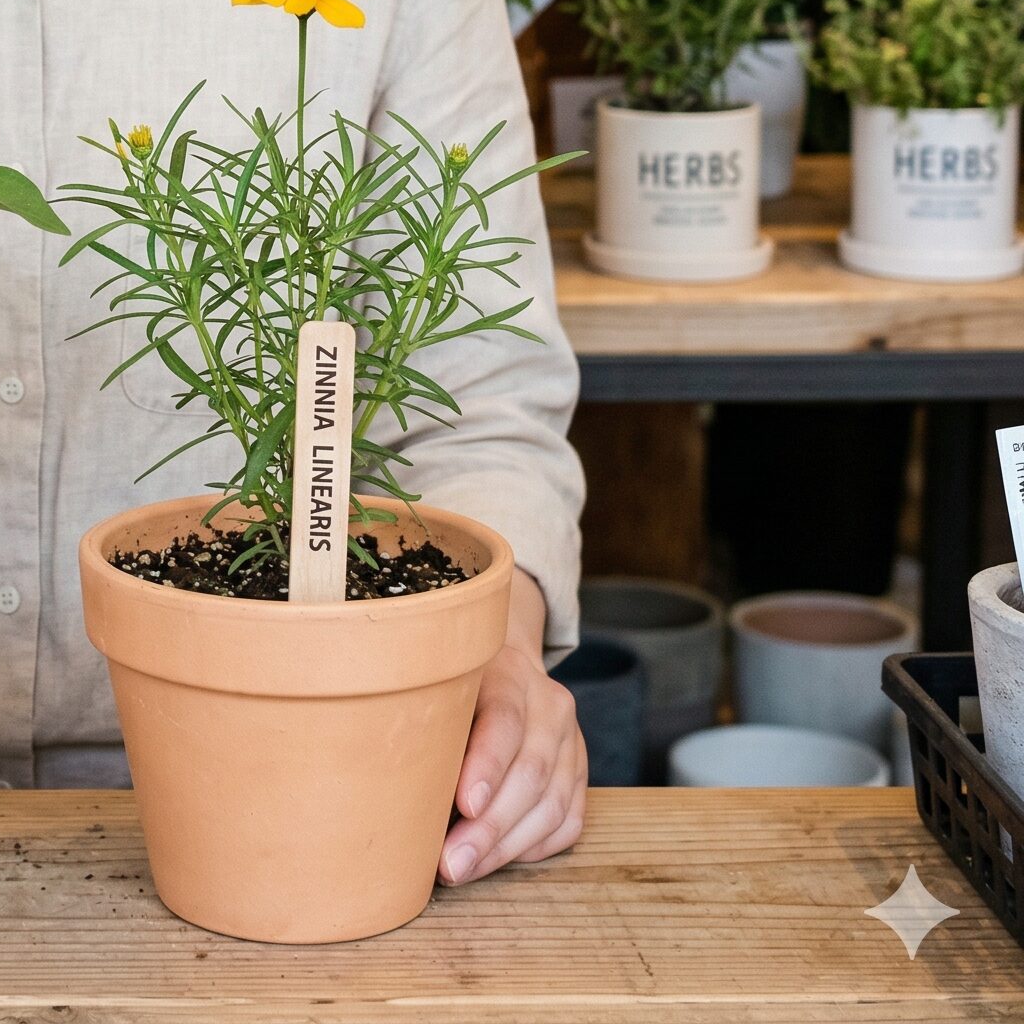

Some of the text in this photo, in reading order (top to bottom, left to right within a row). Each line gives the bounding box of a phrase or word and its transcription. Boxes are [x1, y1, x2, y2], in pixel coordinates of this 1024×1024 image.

[637, 149, 743, 189] HERBS
[894, 142, 999, 182] HERBS
[308, 345, 338, 552] ZINNIA LINEARIS
